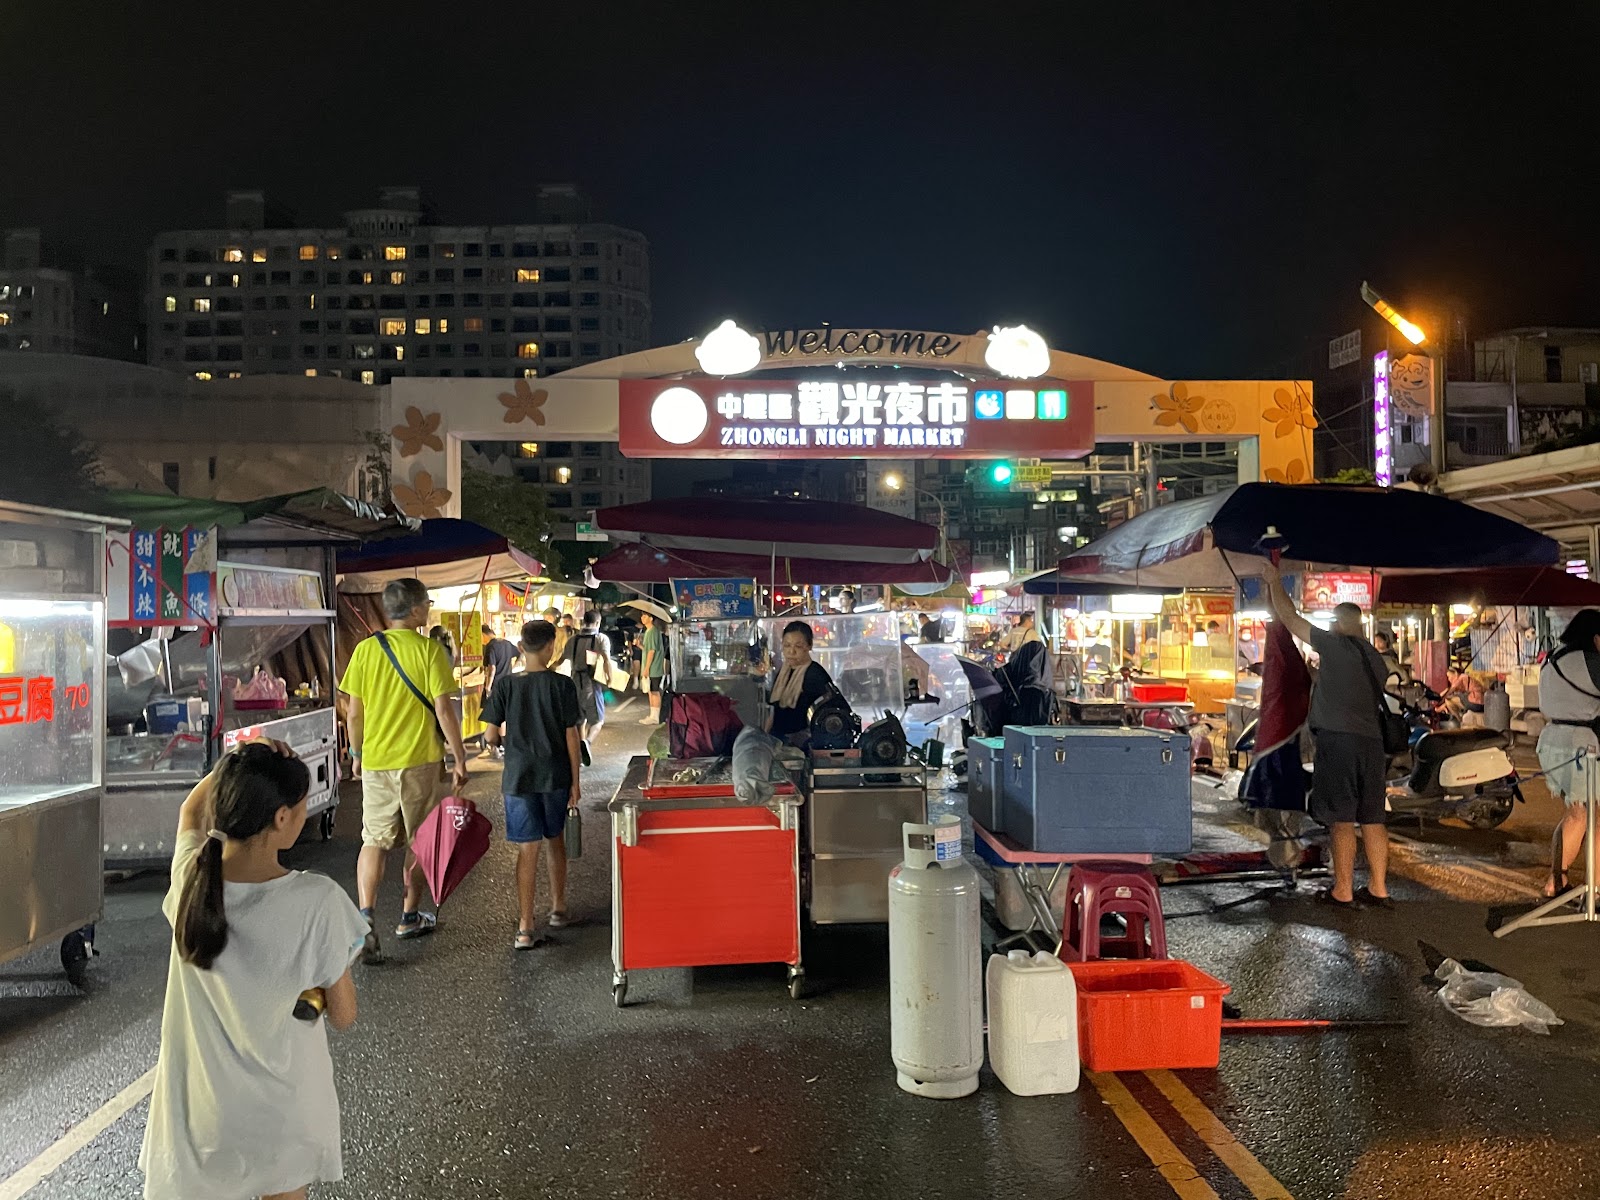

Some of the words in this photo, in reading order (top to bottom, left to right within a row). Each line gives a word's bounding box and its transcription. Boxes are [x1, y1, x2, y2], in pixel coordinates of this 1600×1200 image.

[764, 321, 961, 358] Welcome
[797, 381, 968, 426] 觀光夜市
[720, 427, 807, 446] ZHONGLI
[815, 427, 877, 446] NIGHT
[883, 427, 965, 446] MARKET
[136, 533, 156, 617] 甜不辣
[162, 532, 182, 617] 魷魚
[0, 674, 56, 726] 豆腐
[65, 682, 90, 711] 70
